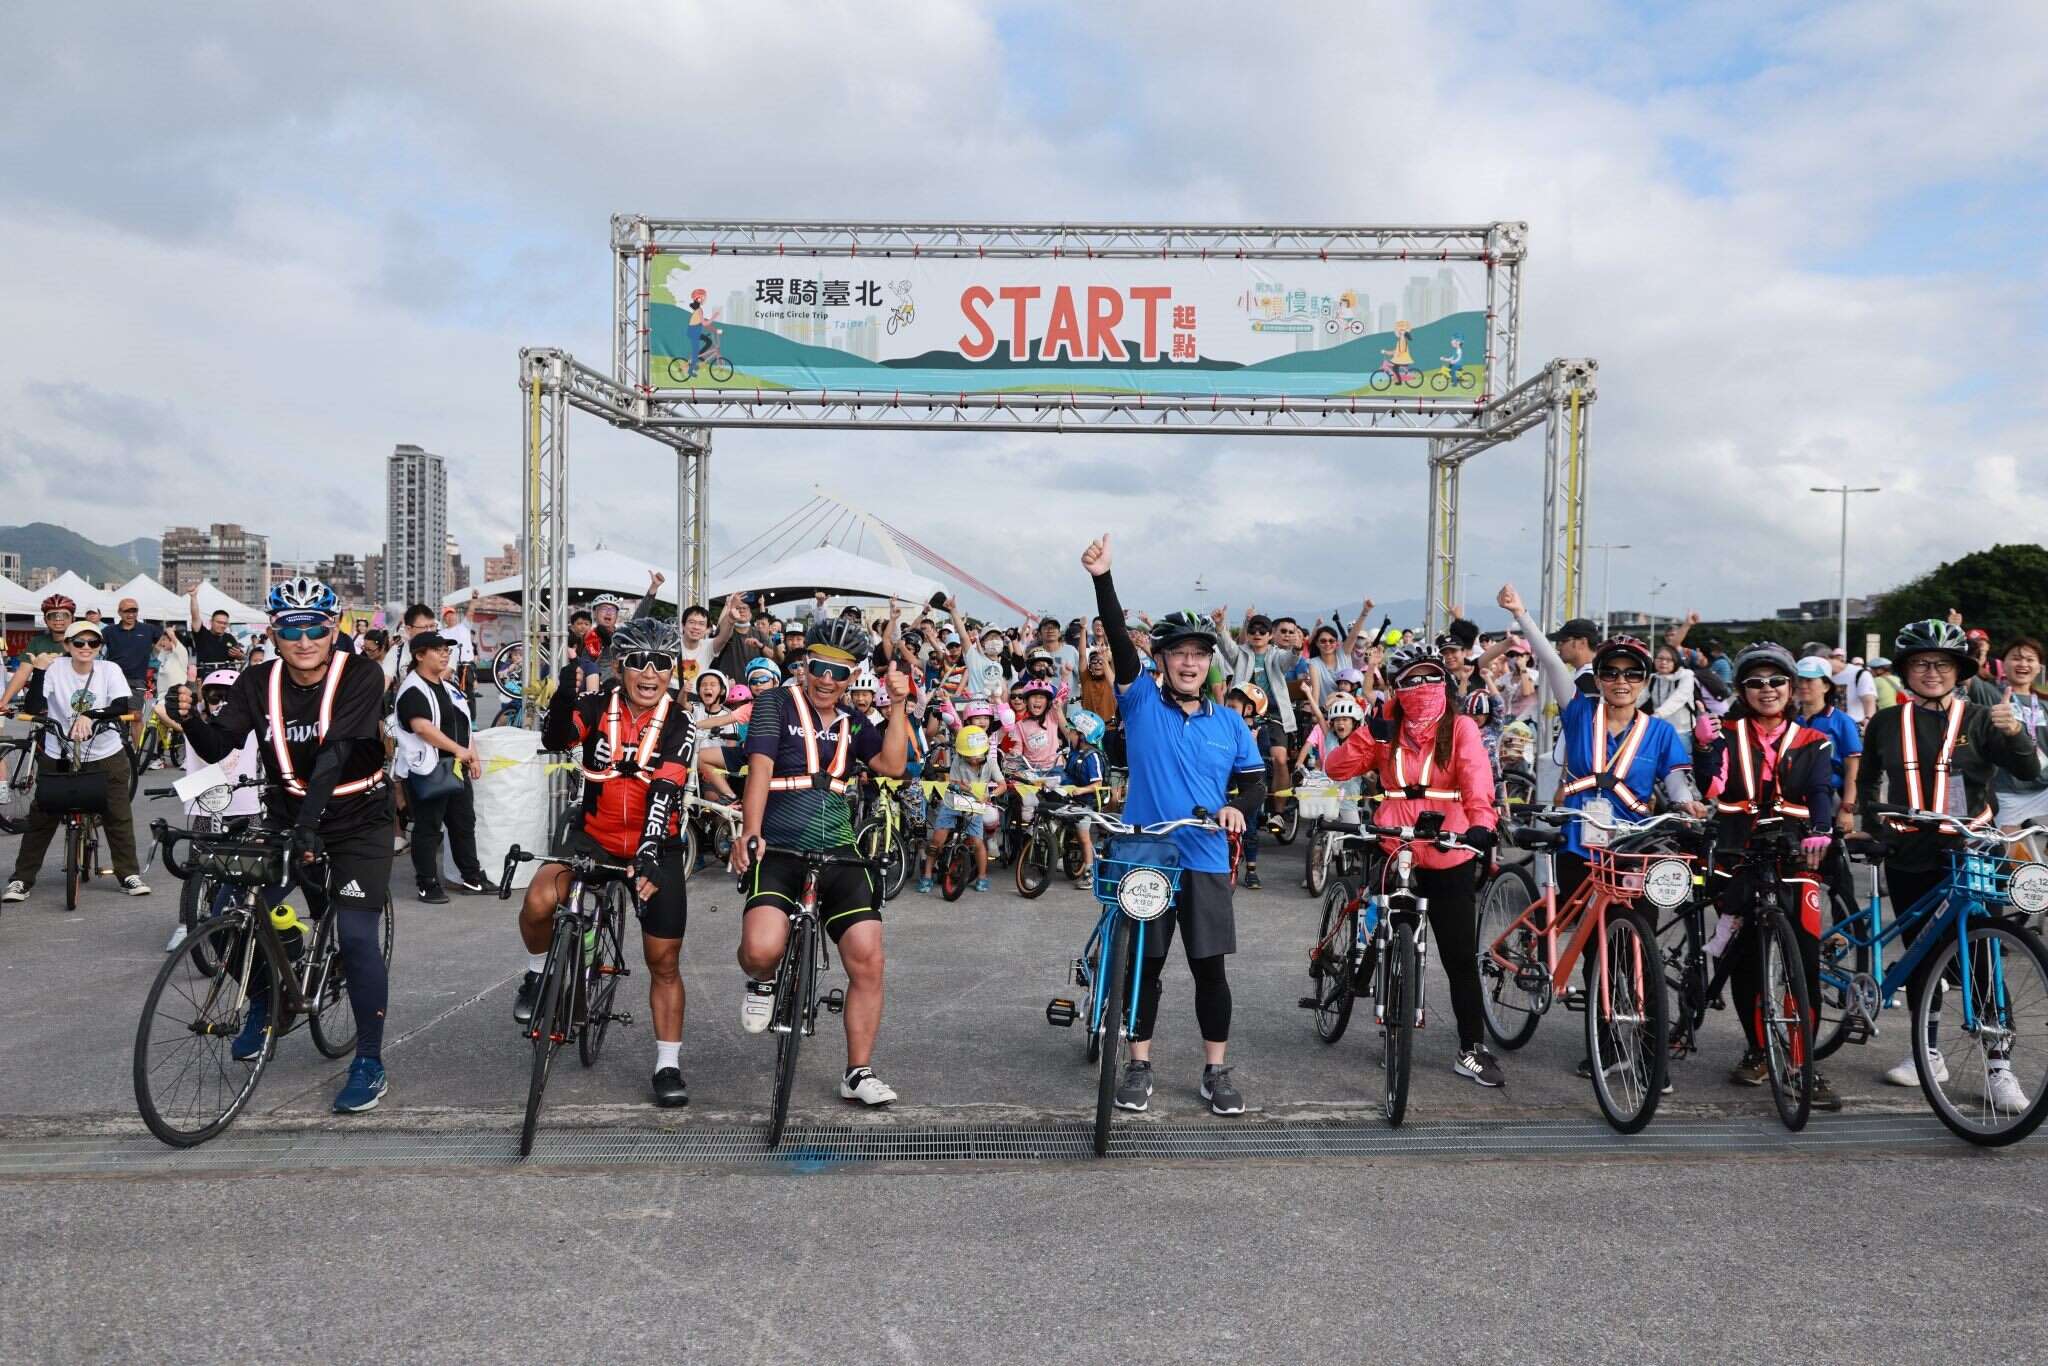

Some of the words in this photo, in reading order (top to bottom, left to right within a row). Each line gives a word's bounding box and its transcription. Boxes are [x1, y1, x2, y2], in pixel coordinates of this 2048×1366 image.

[755, 278, 883, 307] 環騎臺北
[755, 310, 784, 320] Cycling
[787, 310, 810, 320] Circle
[813, 311, 829, 321] Trip
[958, 286, 1172, 358] START
[1172, 304, 1197, 359] 起點
[1150, 882, 1160, 891] 12
